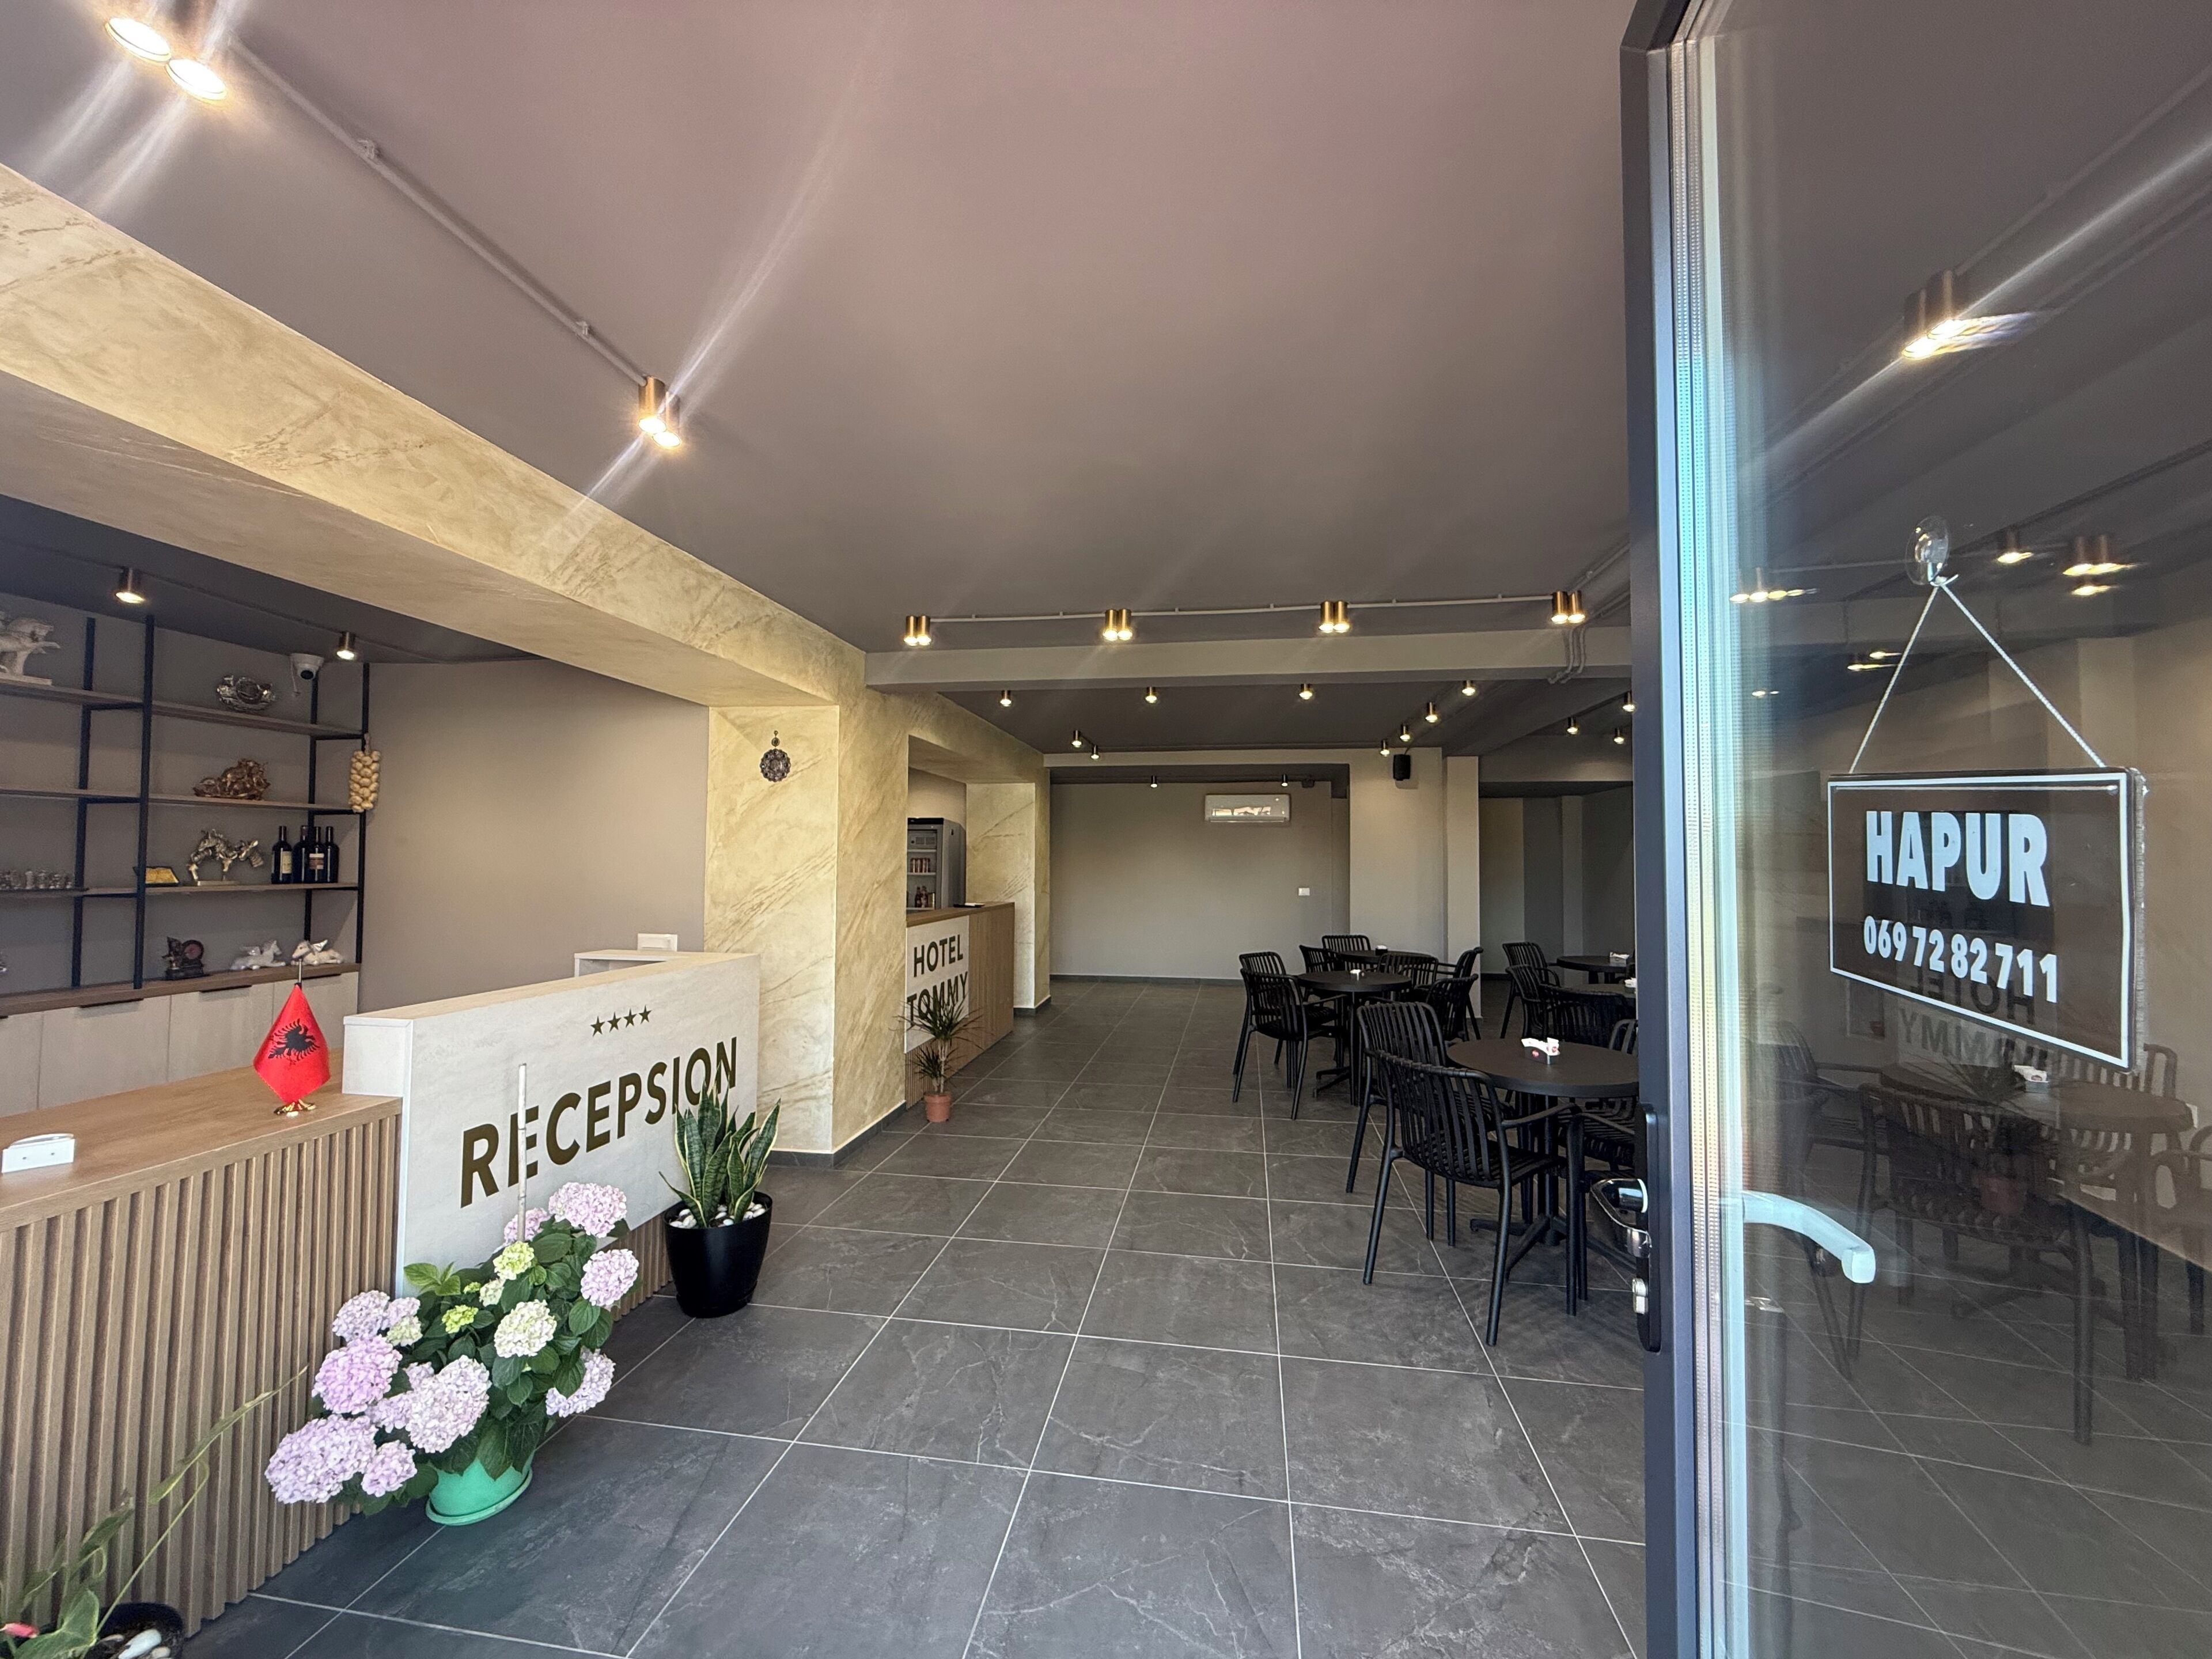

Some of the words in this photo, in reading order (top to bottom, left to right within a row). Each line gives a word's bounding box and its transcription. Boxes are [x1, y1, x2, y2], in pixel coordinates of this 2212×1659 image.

[1866, 810, 2050, 907] HAPUR
[914, 934, 963, 978] HOTEL
[907, 971, 968, 1027] TOMMY
[461, 1036, 737, 1209] RECEPSION
